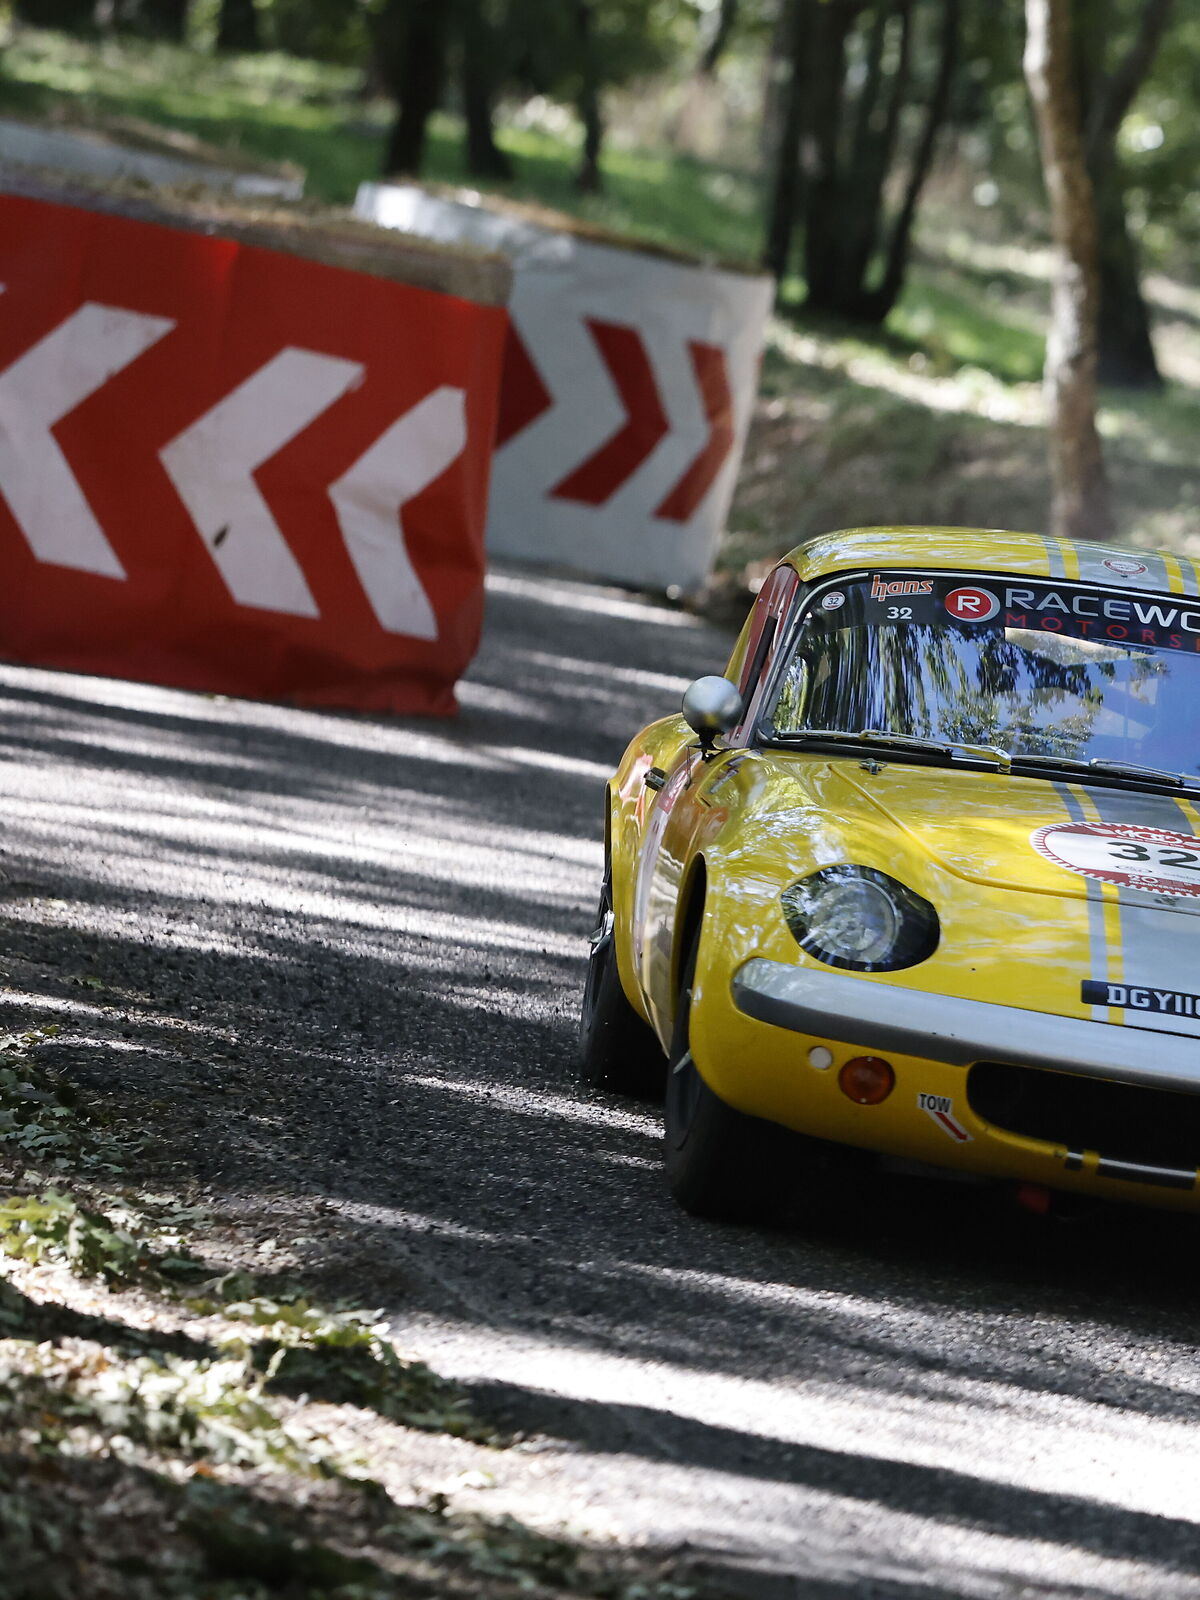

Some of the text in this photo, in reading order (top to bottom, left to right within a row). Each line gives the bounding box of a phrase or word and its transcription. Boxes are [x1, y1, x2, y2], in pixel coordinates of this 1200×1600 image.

[870, 575, 934, 602] hans
[827, 597, 840, 605] 32
[957, 595, 981, 612] R
[887, 607, 913, 620] 32
[919, 1093, 951, 1113] TOW
